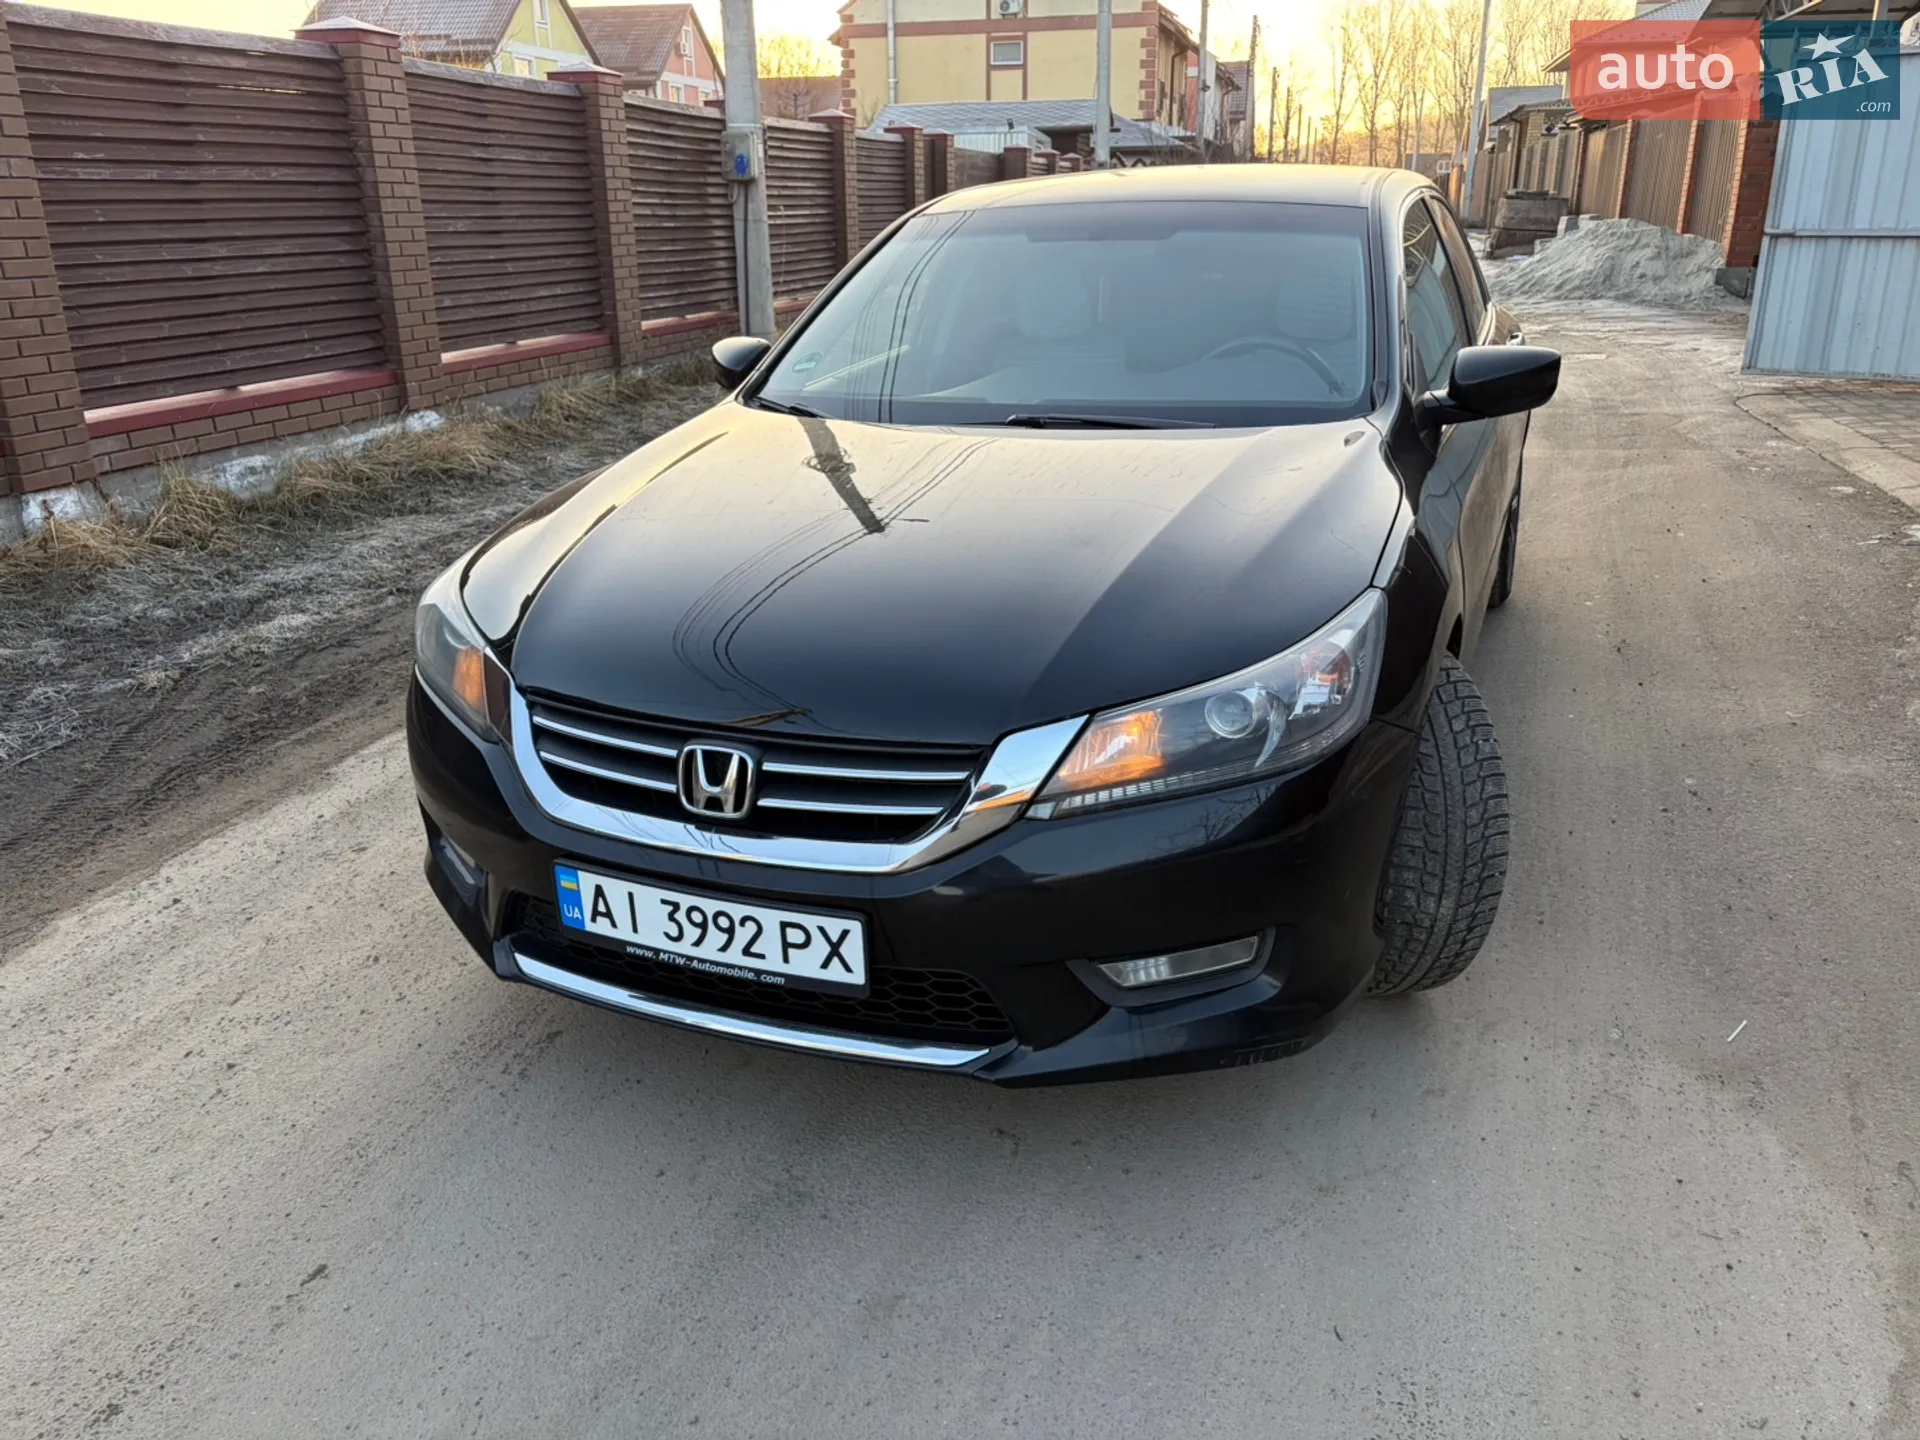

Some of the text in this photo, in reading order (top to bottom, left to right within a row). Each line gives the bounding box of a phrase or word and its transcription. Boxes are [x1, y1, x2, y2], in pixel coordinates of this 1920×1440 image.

[563, 903, 582, 920] UA
[590, 883, 854, 973] AI 3992 PX
